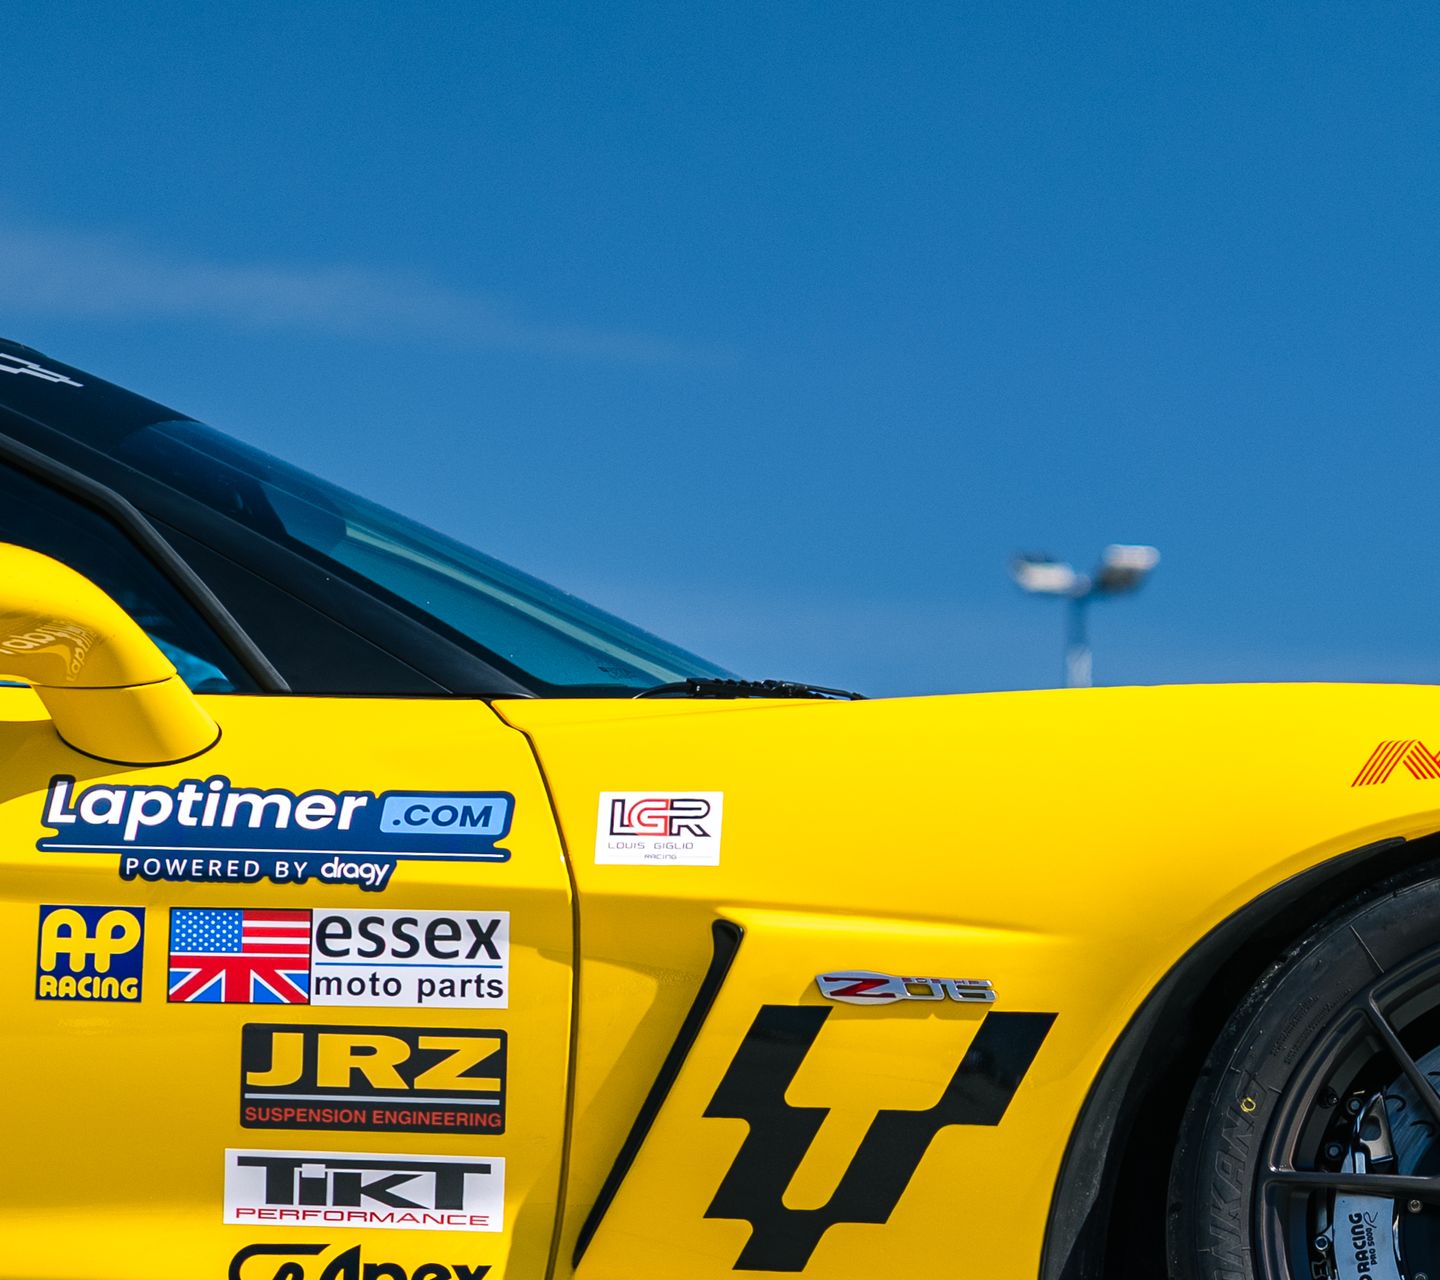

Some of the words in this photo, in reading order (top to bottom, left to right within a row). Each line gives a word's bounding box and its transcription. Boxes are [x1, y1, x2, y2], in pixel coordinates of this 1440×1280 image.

[48, 780, 368, 841] Laptimer
[392, 804, 492, 827] .COM
[126, 858, 260, 877] POWERED
[275, 861, 307, 878] BY
[320, 857, 390, 885] dragy
[40, 908, 141, 973] AP
[316, 915, 501, 959] essex
[39, 975, 138, 999] RACING
[315, 972, 402, 996] moto
[418, 973, 504, 1003] parts
[821, 974, 996, 1004] Z06
[246, 1032, 501, 1091] JRZ
[245, 1107, 366, 1124] SUSPENSION
[372, 1110, 502, 1127] ENGINEERING
[236, 1208, 489, 1226] PERFORMANCE
[1349, 1212, 1370, 1273] RACING
[1368, 1248, 1377, 1265] PRO
